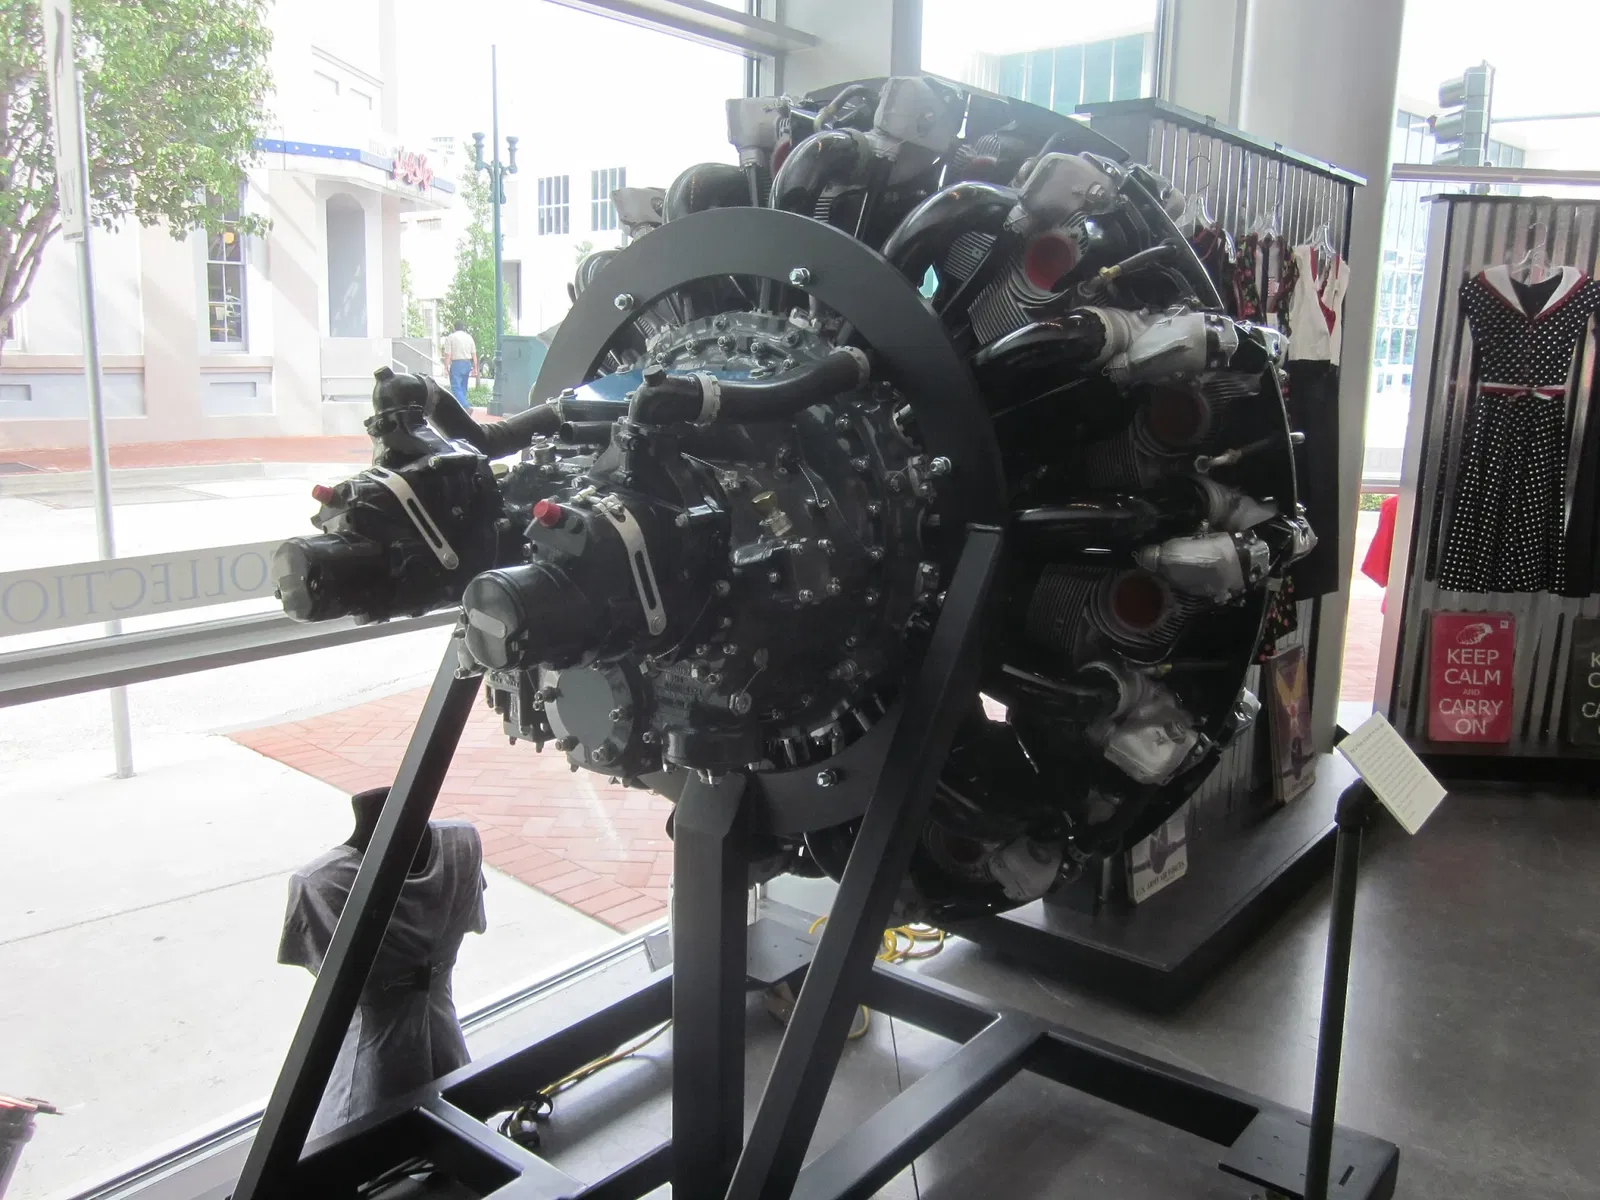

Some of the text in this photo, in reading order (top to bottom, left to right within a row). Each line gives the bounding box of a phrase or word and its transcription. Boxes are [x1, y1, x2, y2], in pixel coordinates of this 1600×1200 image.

[1447, 648, 1499, 665] KEEP
[1444, 668, 1500, 685] CALM
[1462, 688, 1480, 696] AND
[1439, 698, 1503, 716] CARRY
[1455, 718, 1486, 735] ON
